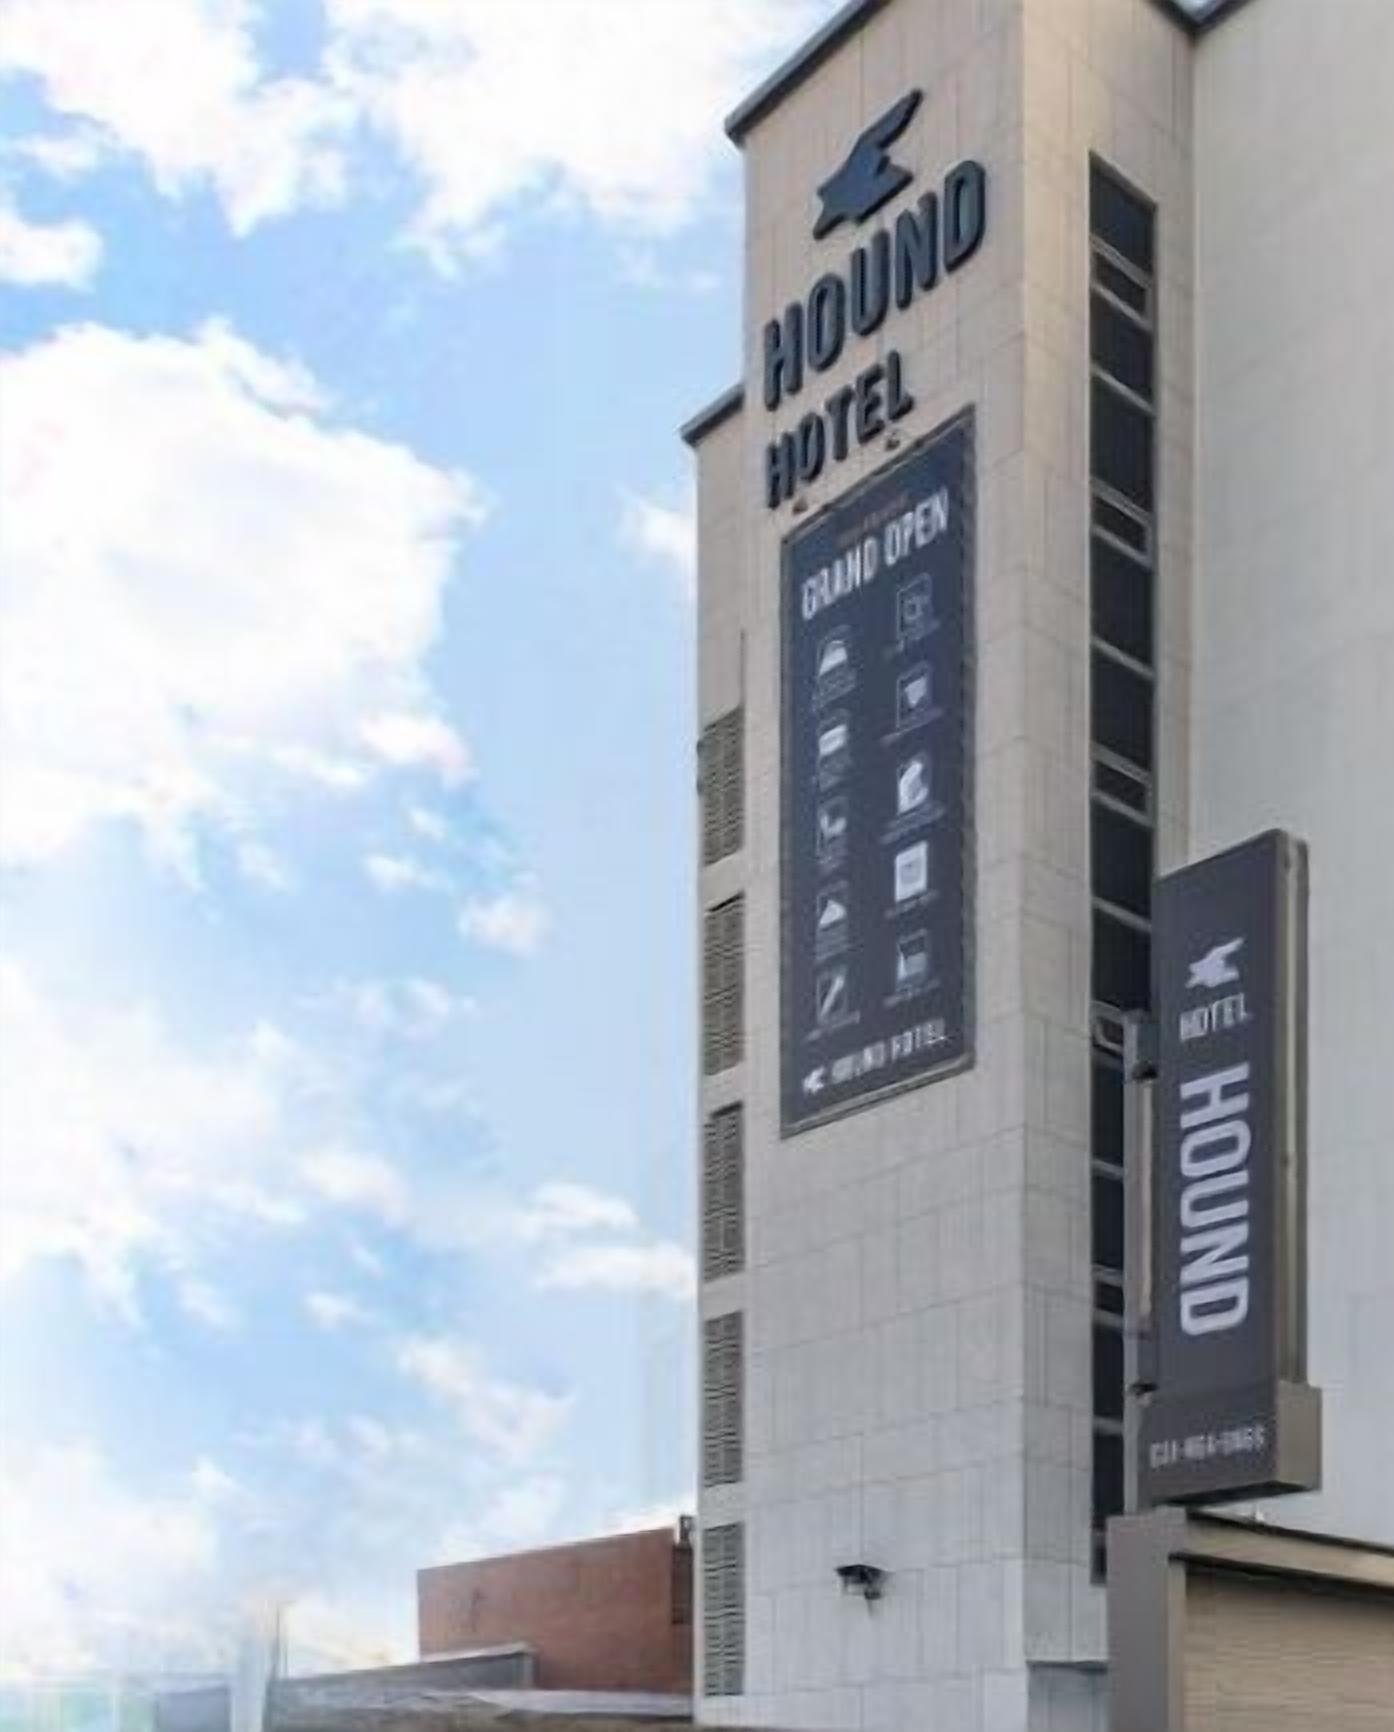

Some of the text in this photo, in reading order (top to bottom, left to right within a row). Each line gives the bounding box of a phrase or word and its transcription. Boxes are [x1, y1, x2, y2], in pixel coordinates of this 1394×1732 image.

[763, 159, 986, 412] HOUND
[765, 350, 915, 509] HOTEL
[802, 536, 879, 621] GRAND
[884, 485, 949, 568] OPEN
[1180, 992, 1249, 1042] HOTEL
[1179, 1061, 1252, 1337] HOUND
